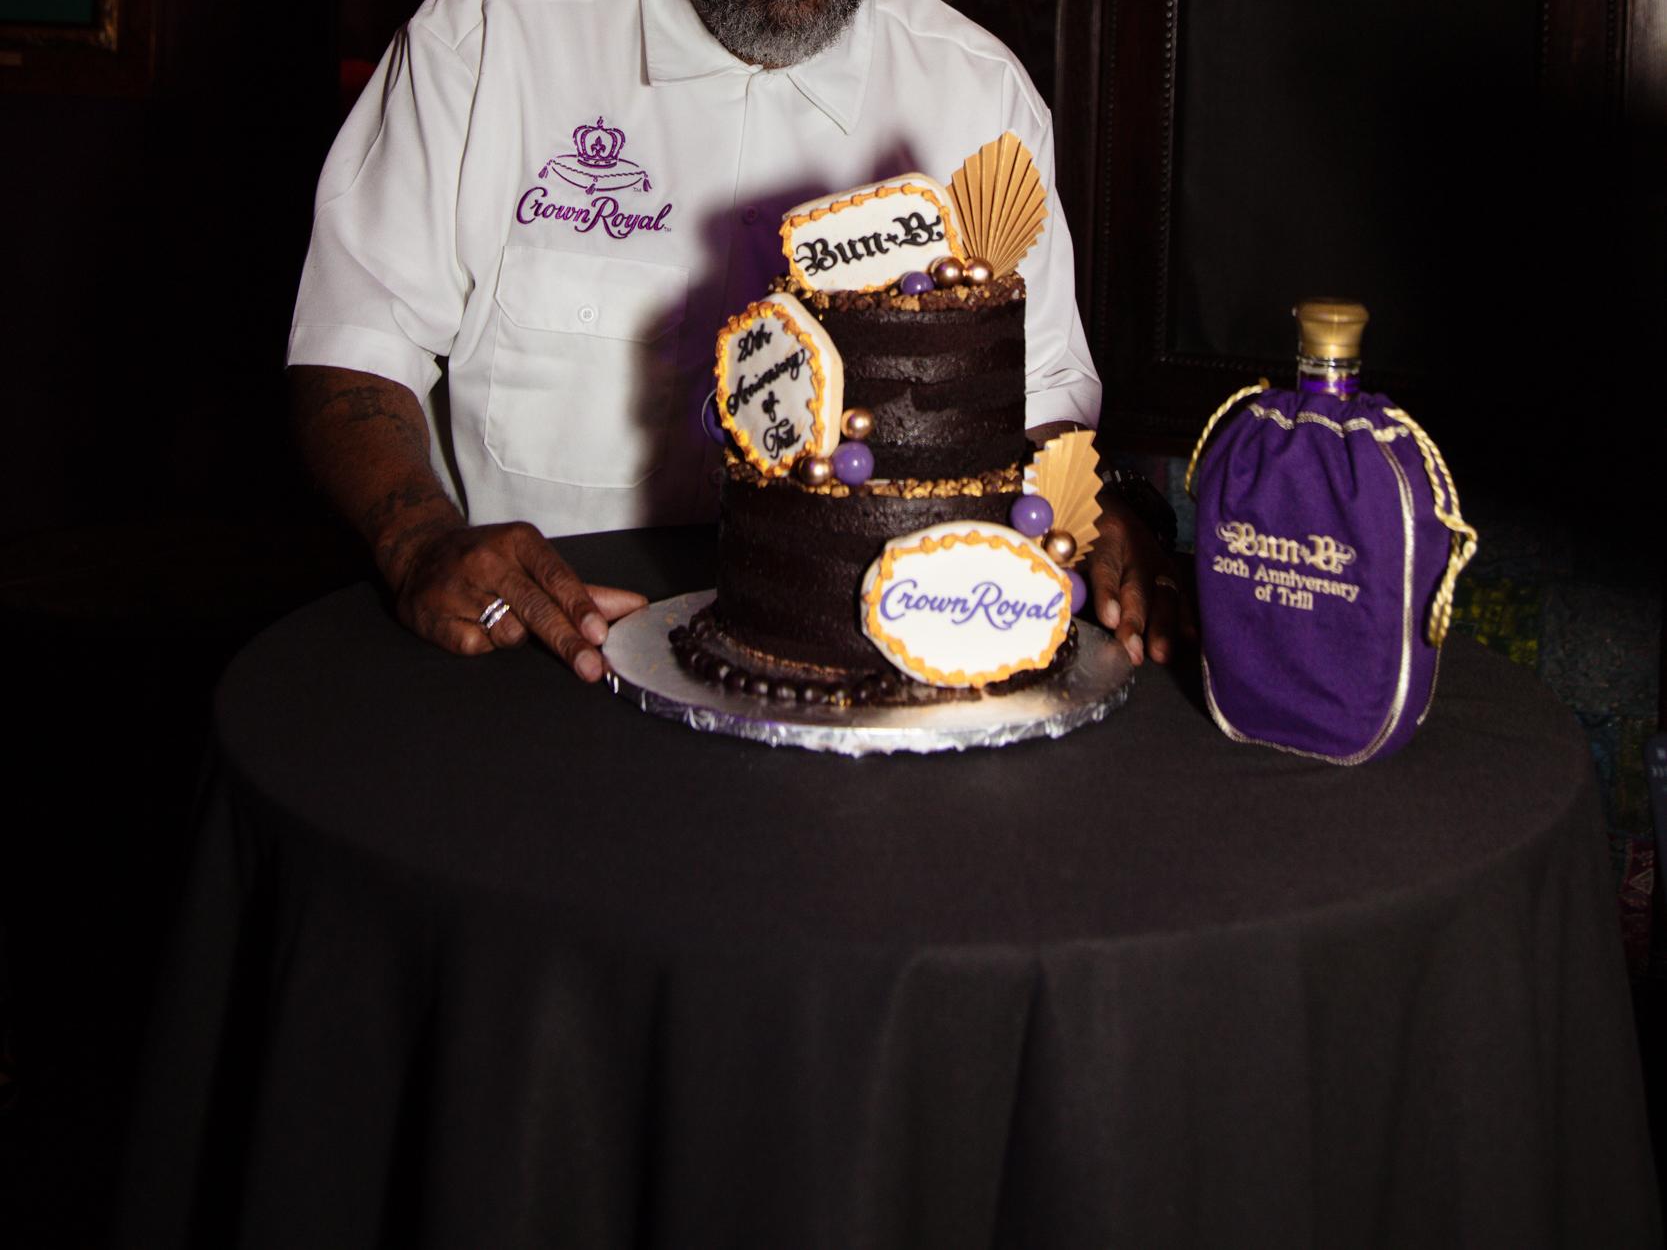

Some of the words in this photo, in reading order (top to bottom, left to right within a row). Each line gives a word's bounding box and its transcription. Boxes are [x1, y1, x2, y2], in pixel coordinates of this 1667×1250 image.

[516, 186, 590, 225] Crown
[574, 196, 673, 240] Royal
[879, 578, 971, 621] Crown
[951, 581, 1065, 631] Royal
[1212, 554, 1250, 579] 20th
[1253, 562, 1361, 604] Anniversary
[1254, 583, 1274, 603] of
[1276, 586, 1314, 612] Trill
